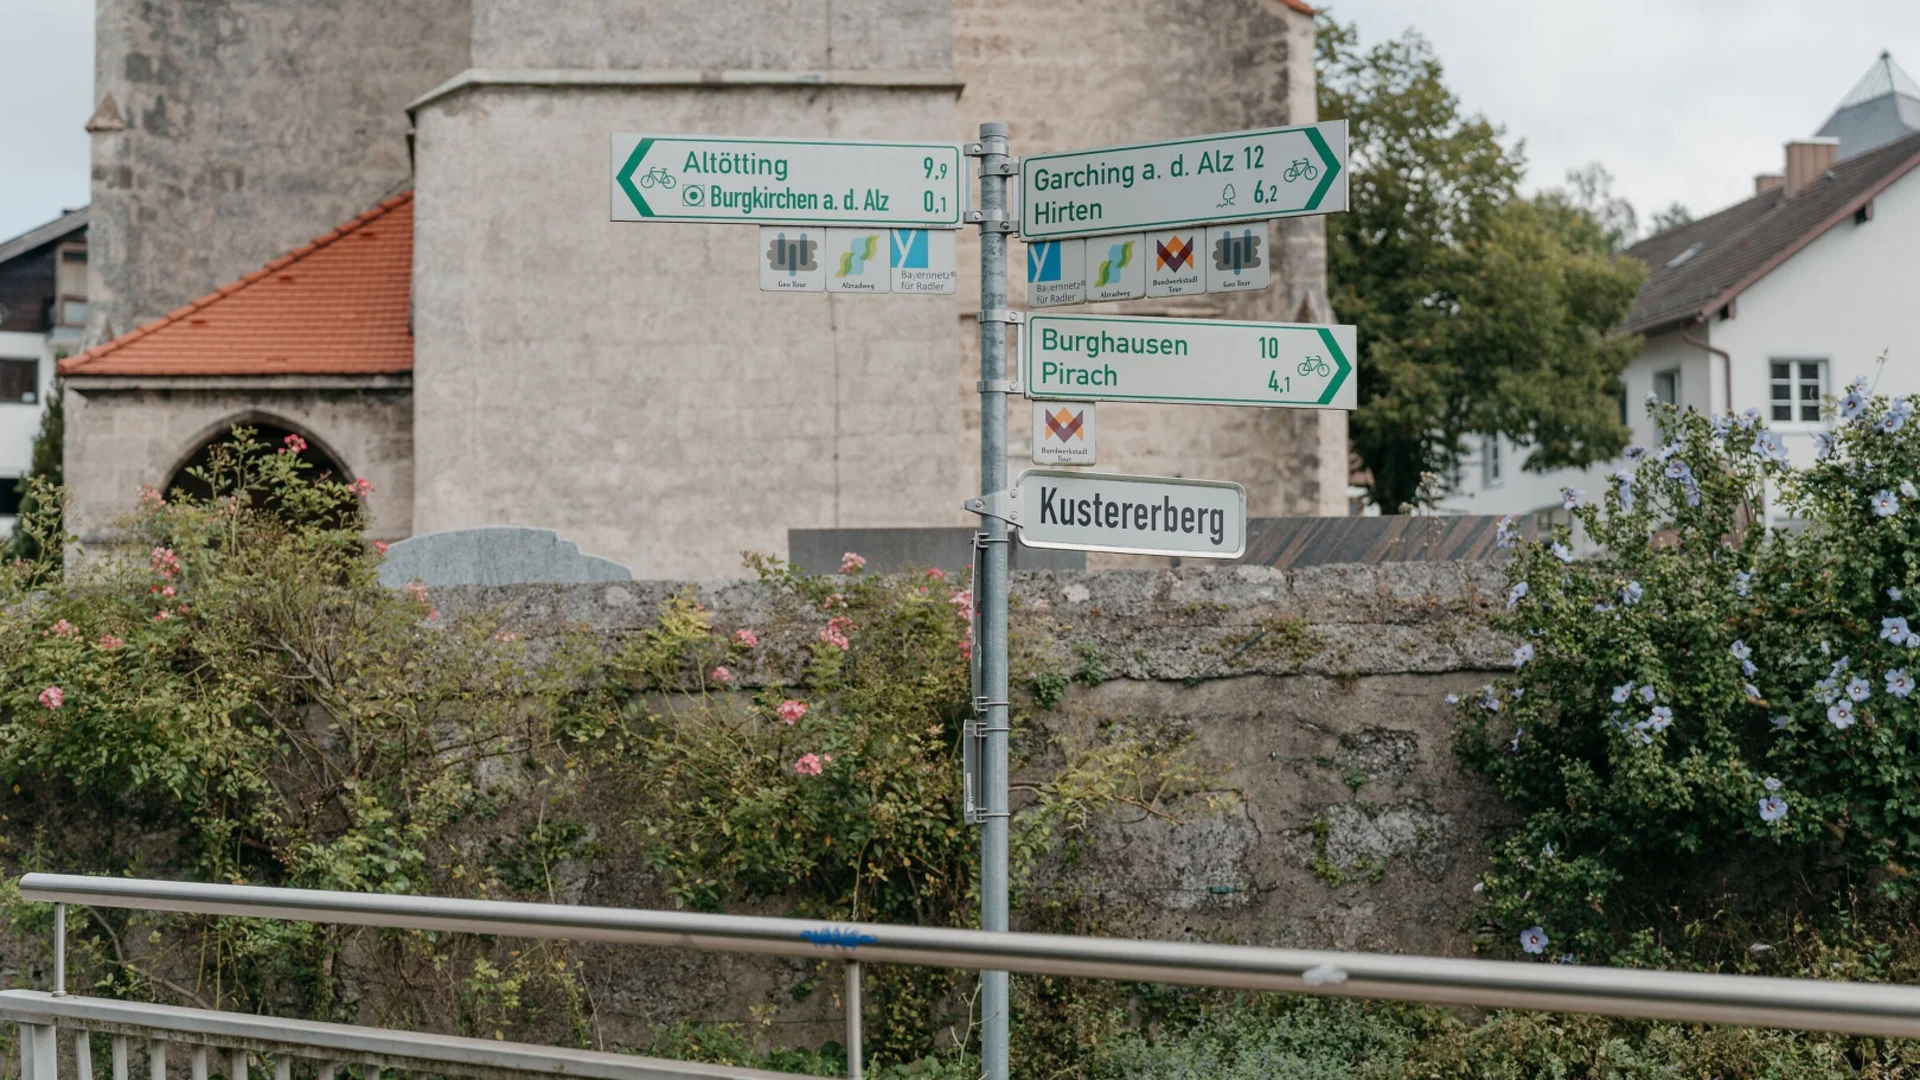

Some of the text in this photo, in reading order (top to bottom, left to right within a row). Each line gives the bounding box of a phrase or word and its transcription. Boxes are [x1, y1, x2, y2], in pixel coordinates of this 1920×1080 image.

[683, 151, 948, 181] Altötting 9,9
[1035, 145, 1265, 191] Garching a. d. Alz 12
[710, 185, 947, 214] Burgkirchen a. d. Alz 0,1
[1034, 180, 1278, 225] Hirten 6,2
[901, 282, 945, 291] für Radler
[1036, 293, 1076, 304] für Radler
[1042, 328, 1279, 359] Burghausen 10
[1042, 362, 1290, 393] Pirach 4,1
[1040, 486, 1224, 545] Kustererberg
